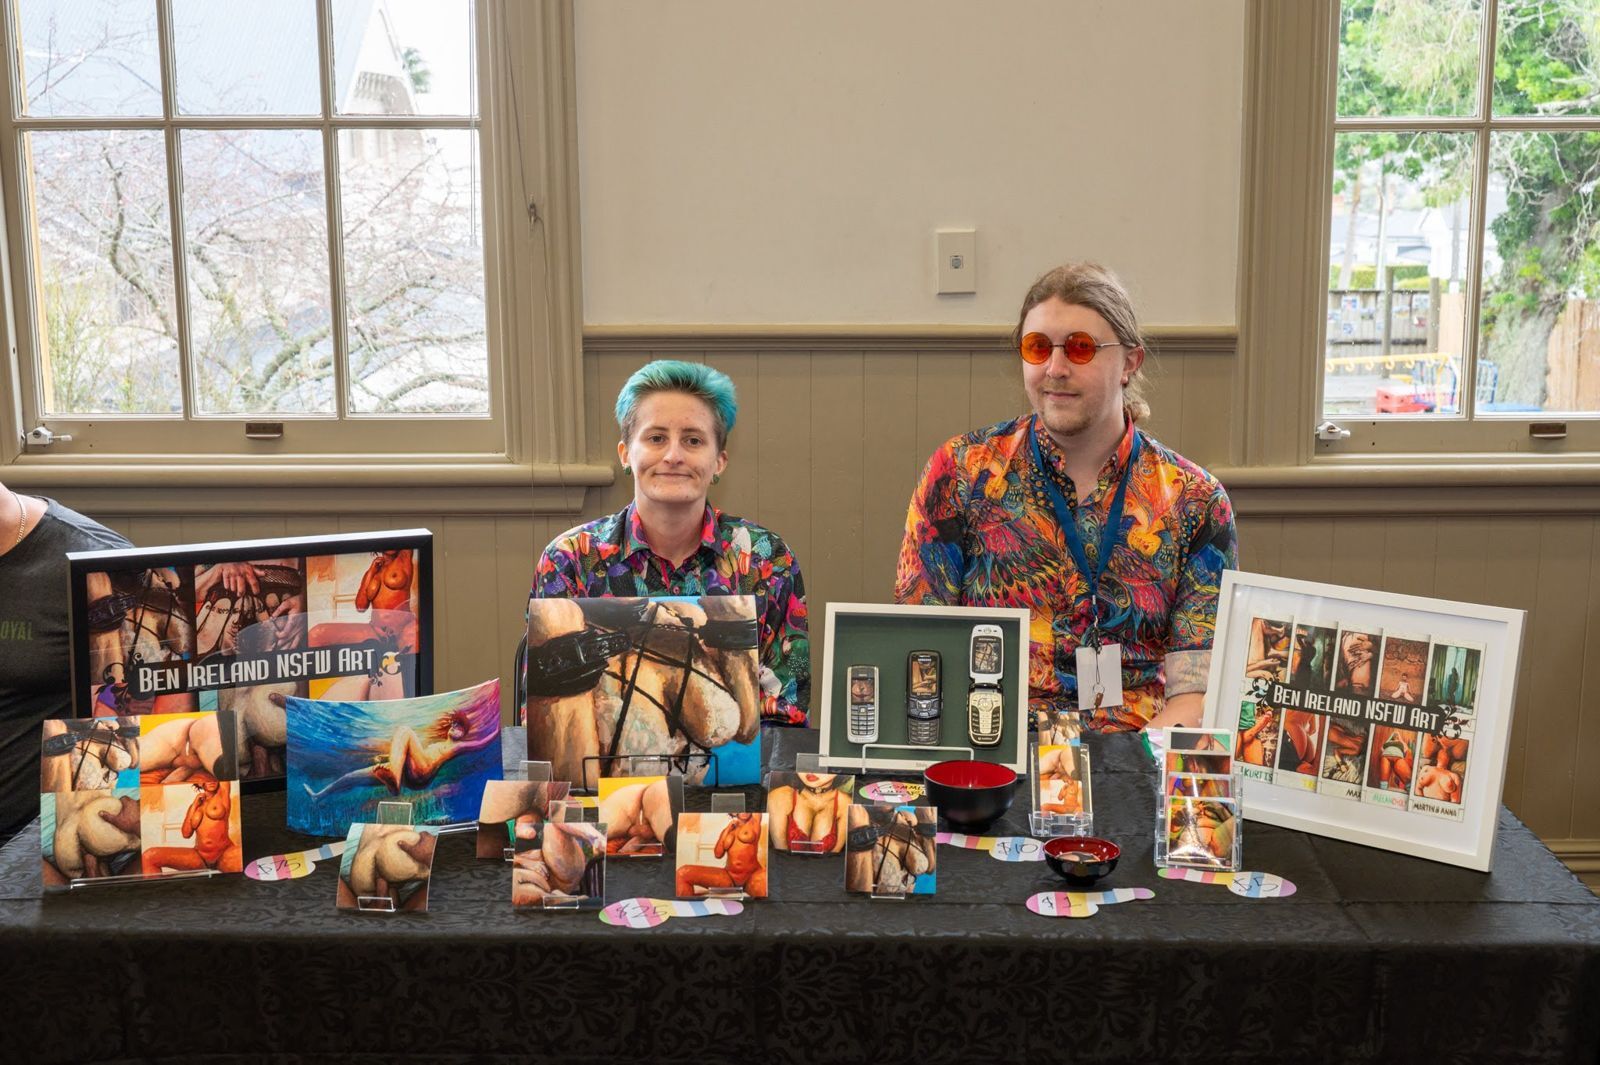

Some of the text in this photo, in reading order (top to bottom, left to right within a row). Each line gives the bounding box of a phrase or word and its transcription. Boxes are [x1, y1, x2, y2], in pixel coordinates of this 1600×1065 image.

[276, 650, 333, 678] NSFW
[1365, 699, 1407, 725] NSFW
[997, 841, 1038, 855] $10
[1232, 876, 1279, 892] $5
[616, 902, 668, 919] $25
[1041, 896, 1082, 909] $1
